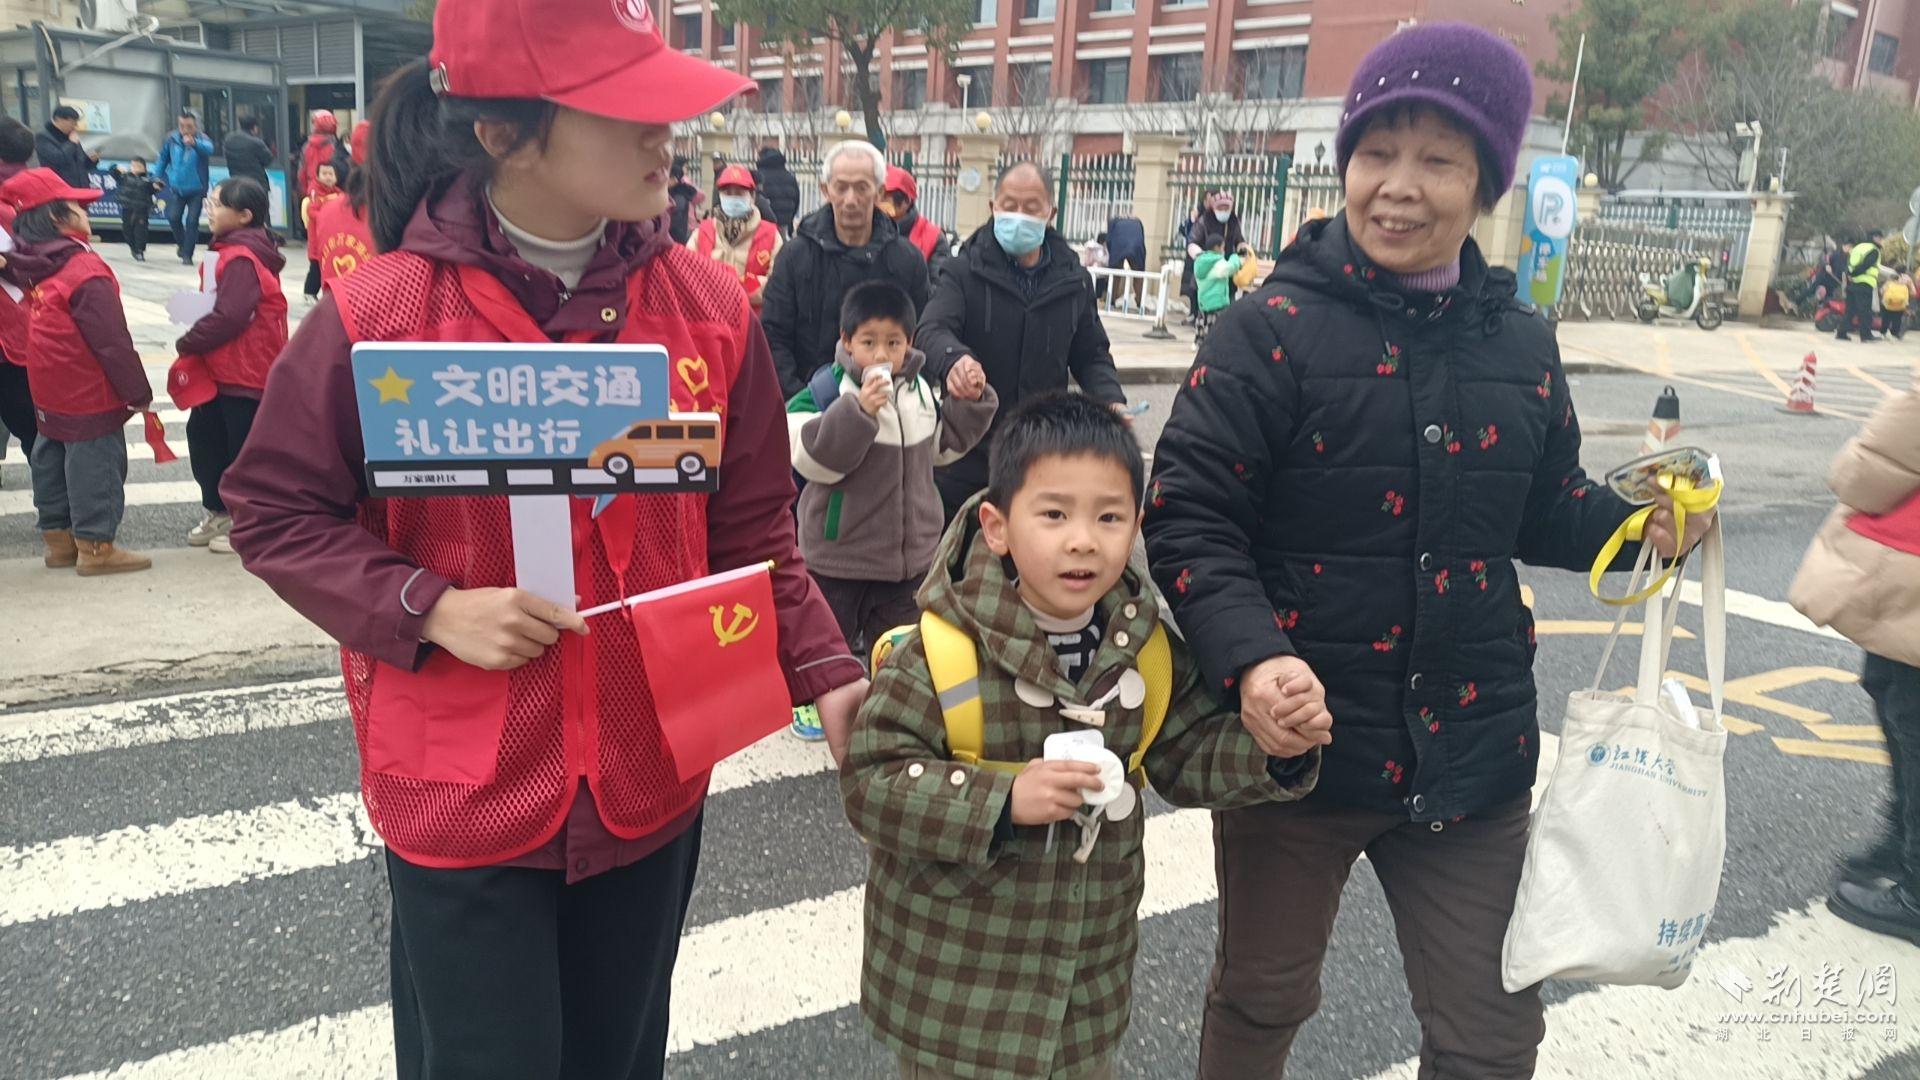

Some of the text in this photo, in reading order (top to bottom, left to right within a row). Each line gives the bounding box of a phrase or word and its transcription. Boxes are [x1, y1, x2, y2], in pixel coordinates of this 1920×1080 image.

[431, 363, 642, 408] 文明交通
[394, 418, 581, 457] 礼让出行
[1610, 761, 1709, 798] JIANGHAN UNIVERSITY
